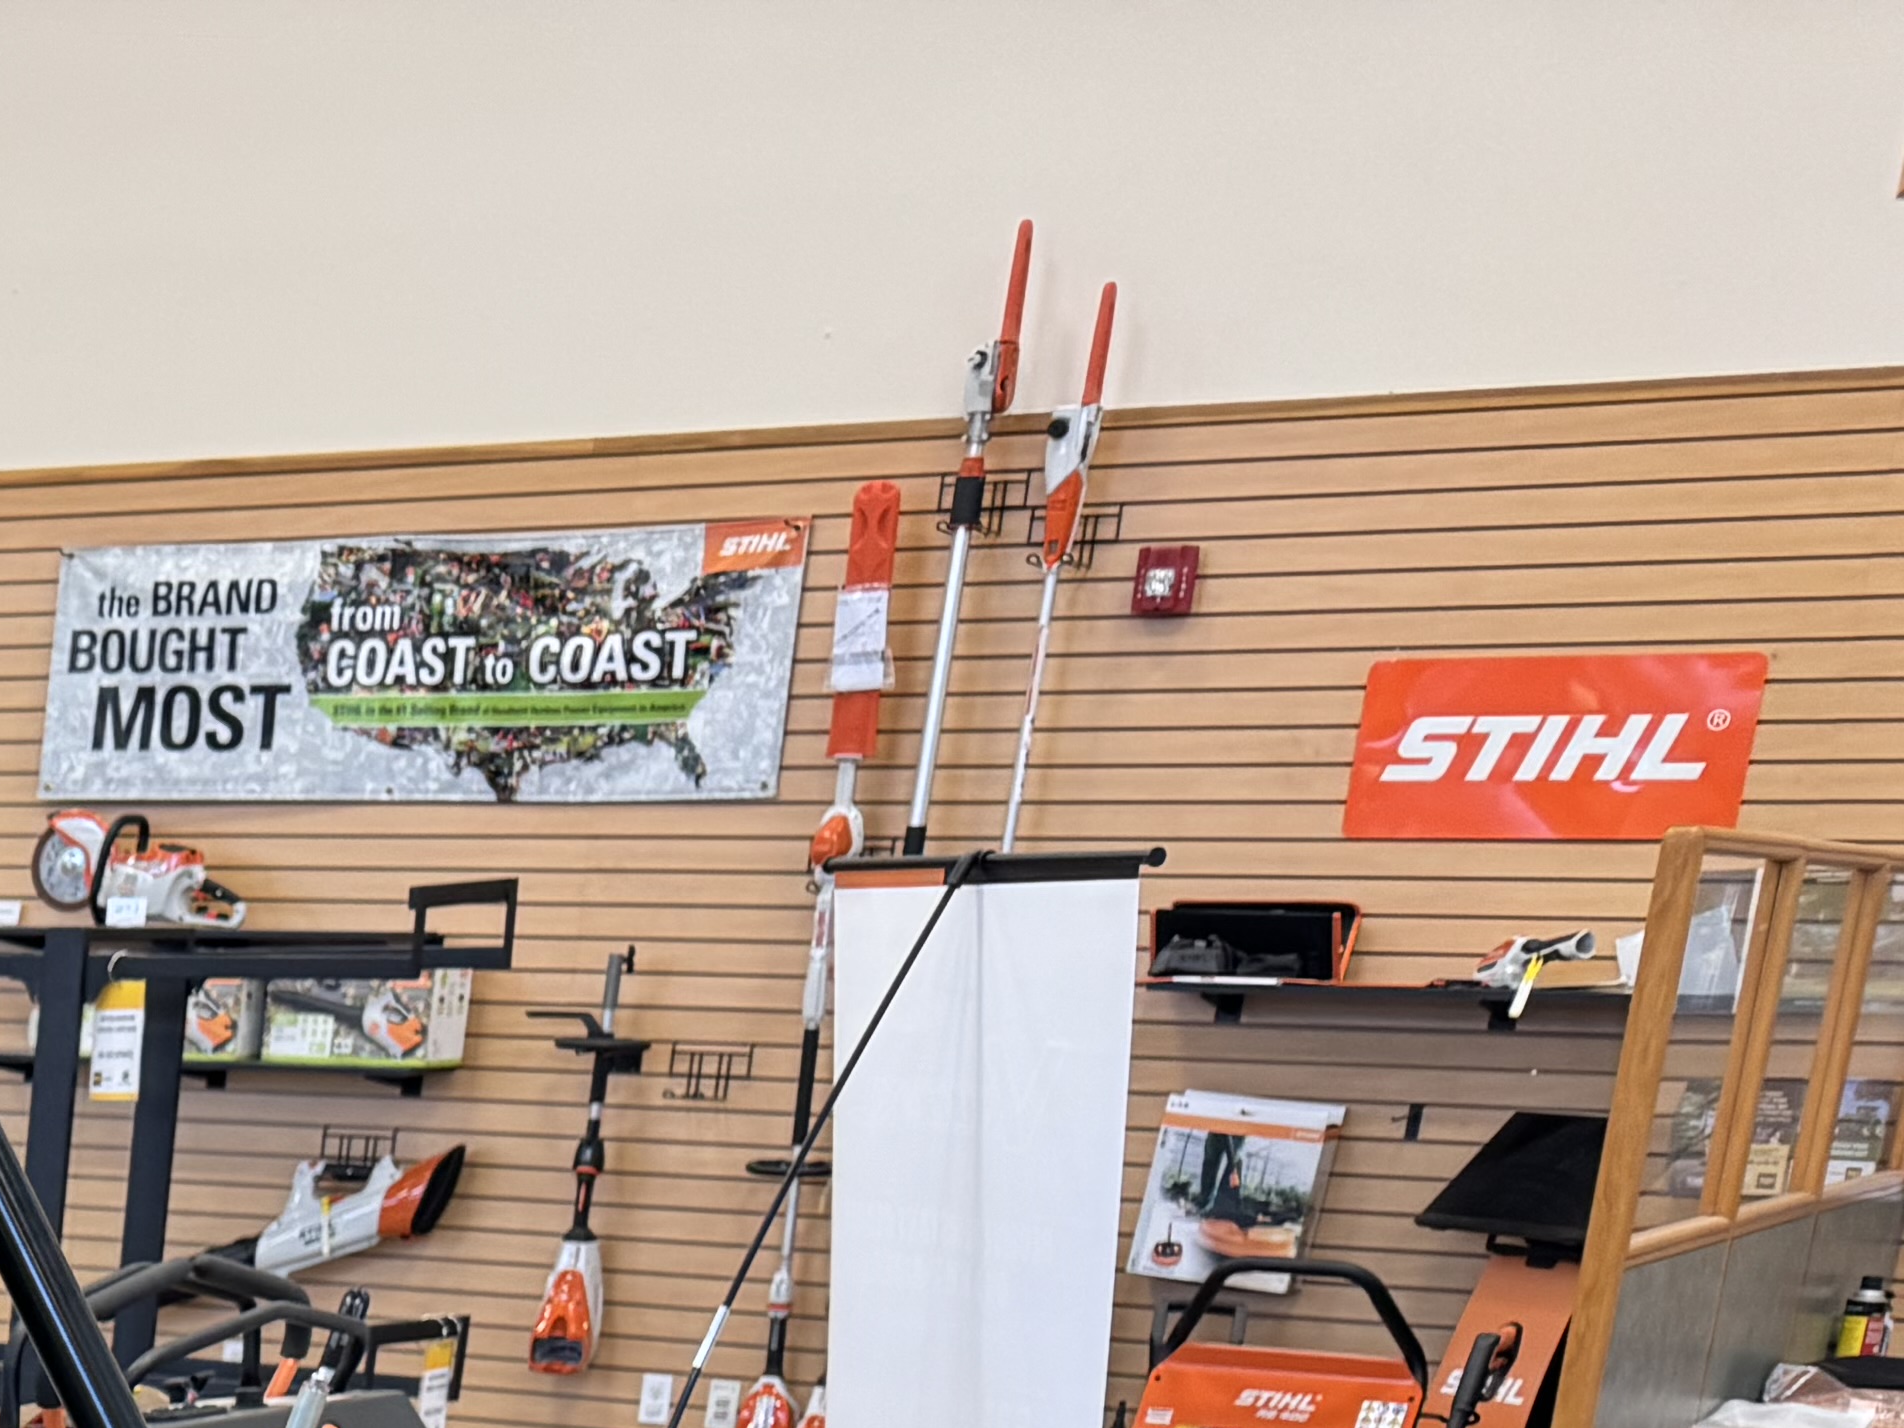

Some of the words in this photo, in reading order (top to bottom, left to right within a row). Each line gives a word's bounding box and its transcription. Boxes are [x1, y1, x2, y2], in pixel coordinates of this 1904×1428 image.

[719, 531, 789, 557] STIHL
[97, 586, 140, 619] the
[152, 578, 278, 618] BRAND
[331, 598, 402, 633] from
[68, 626, 248, 675] BOUGHT
[326, 636, 476, 687] COAST
[485, 653, 514, 685] to
[528, 629, 697, 686] COAST
[92, 684, 292, 752] MOST
[1379, 712, 1707, 783] STIHL
[1235, 1388, 1318, 1414] STIHL
[1440, 1368, 1524, 1407] SHL
